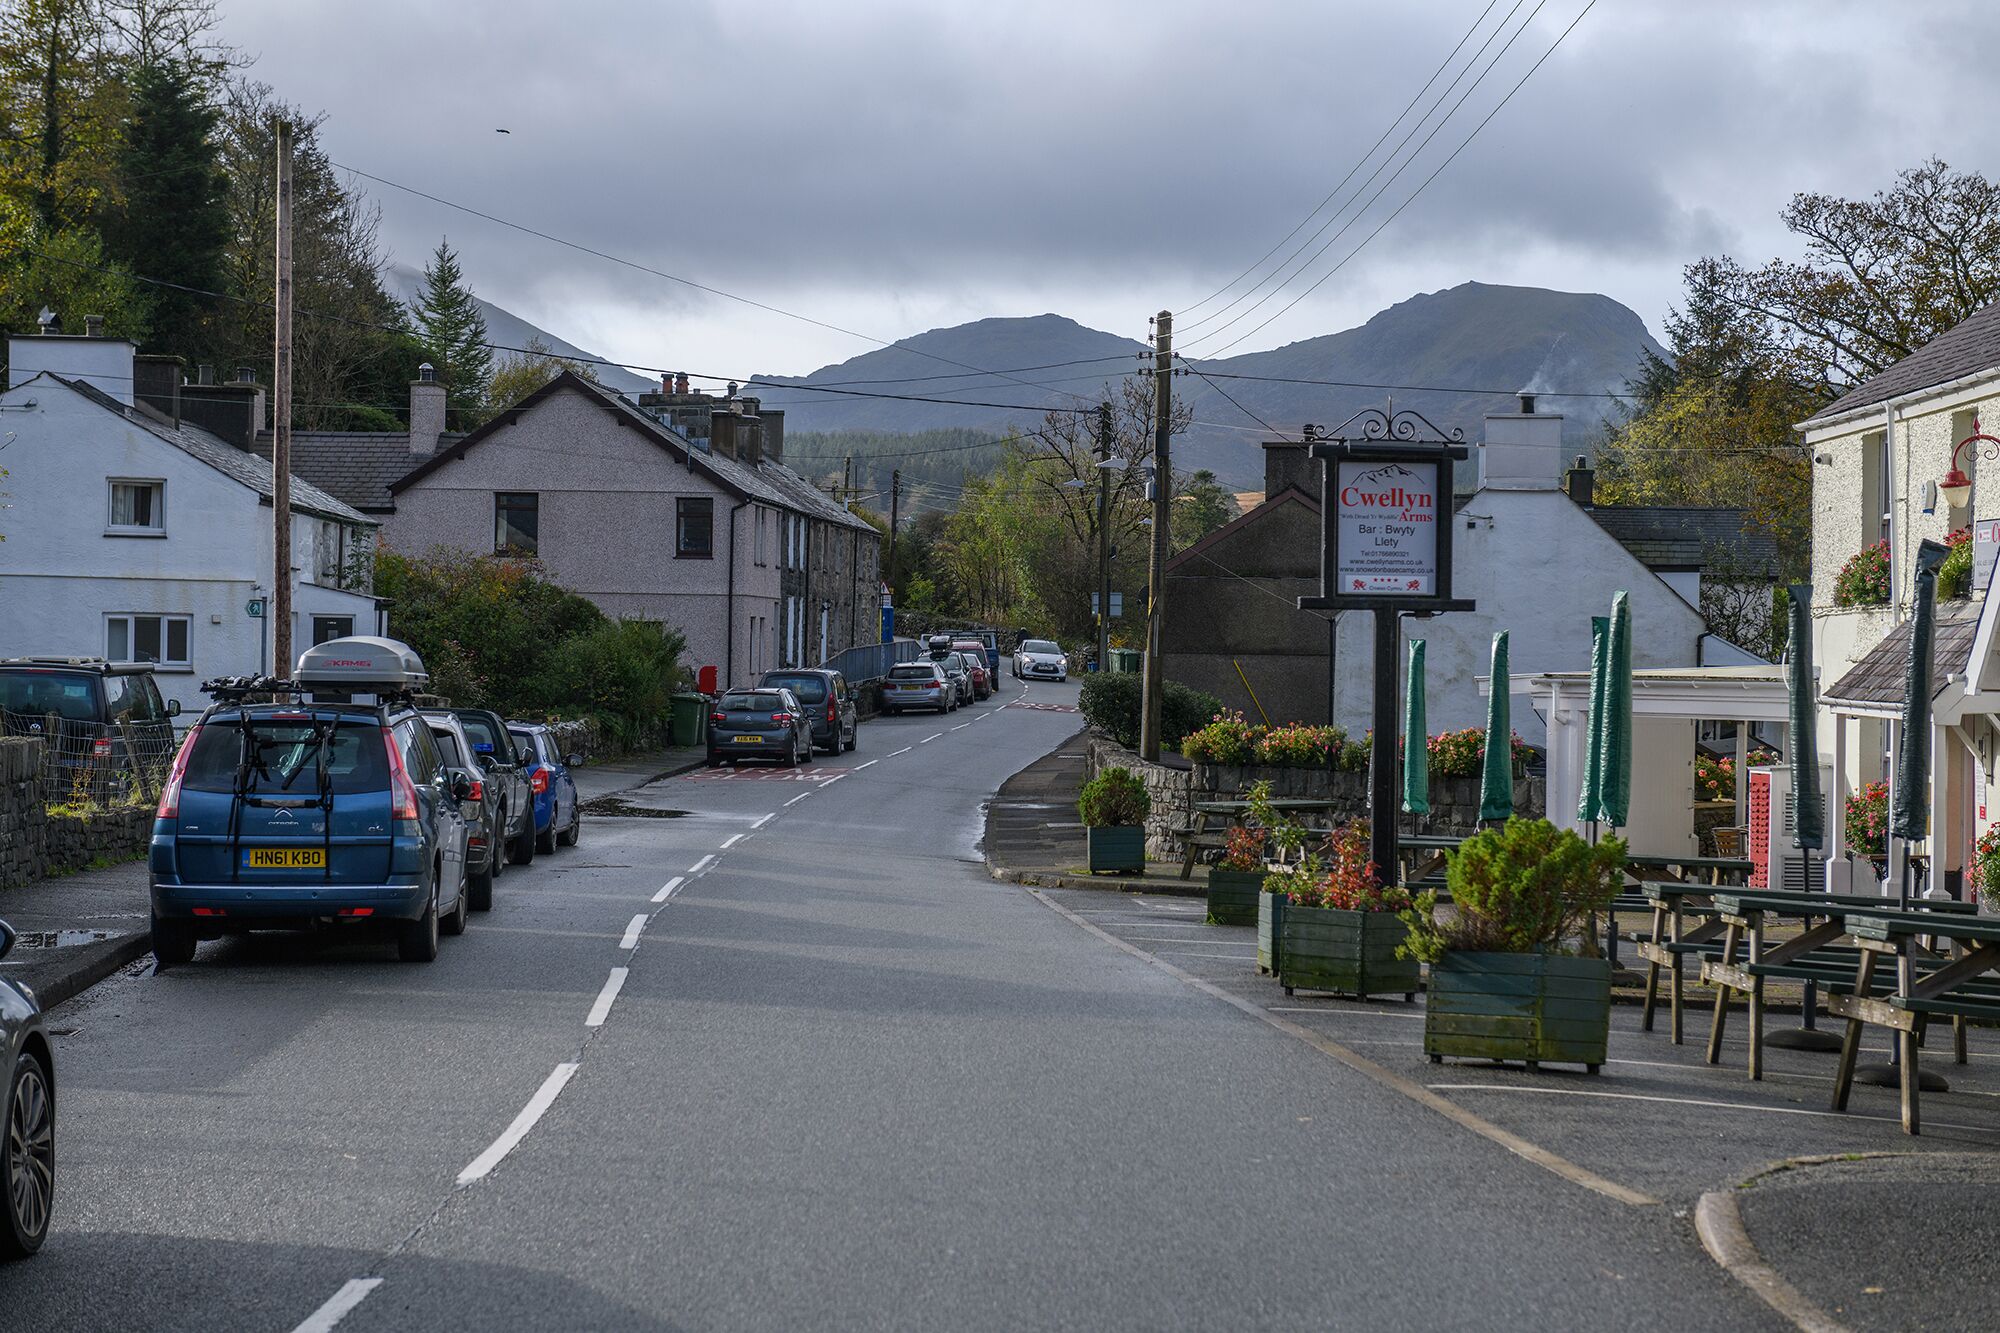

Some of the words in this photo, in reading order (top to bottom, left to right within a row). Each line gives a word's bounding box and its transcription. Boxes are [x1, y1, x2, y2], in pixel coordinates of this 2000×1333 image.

[1341, 487, 1432, 511] Cwellyn
[1398, 511, 1433, 523] Arms
[1358, 524, 1377, 534] Bar
[1385, 524, 1416, 537] Bwyty
[1374, 536, 1399, 548] Llety
[254, 851, 287, 864] HN61
[291, 851, 321, 865] KBO
